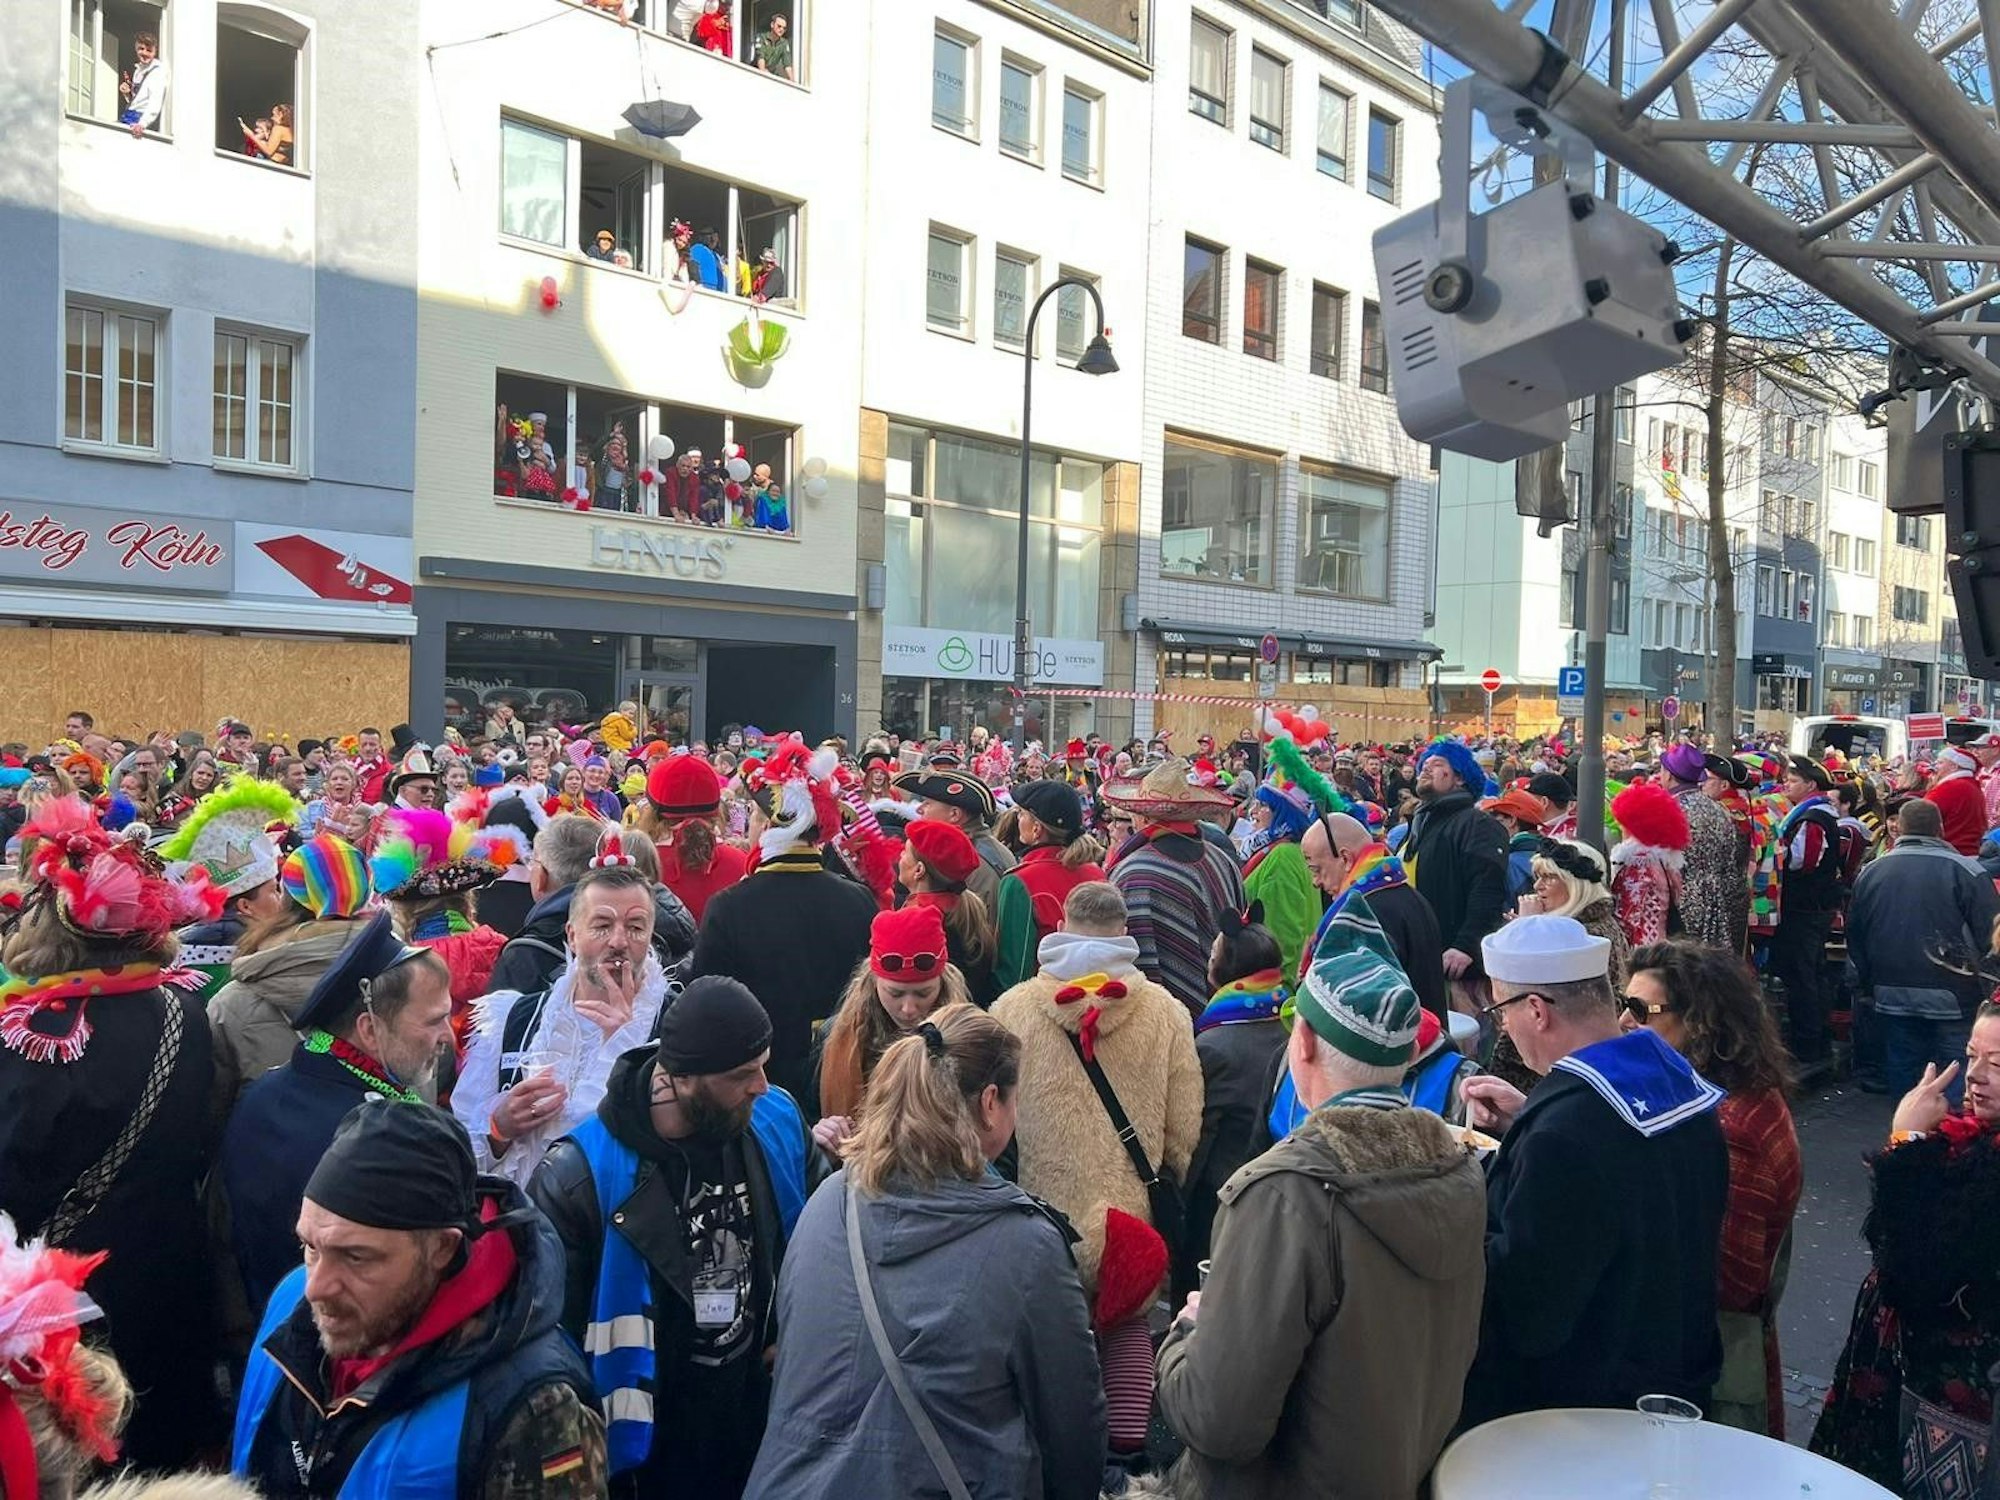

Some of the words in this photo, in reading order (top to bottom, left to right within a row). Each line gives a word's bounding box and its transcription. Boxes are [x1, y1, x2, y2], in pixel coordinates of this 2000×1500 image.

[106, 519, 226, 571] Köln
[1164, 632, 1185, 642] ROSA
[888, 643, 926, 653] STETSON
[1307, 643, 1324, 653] ROSA
